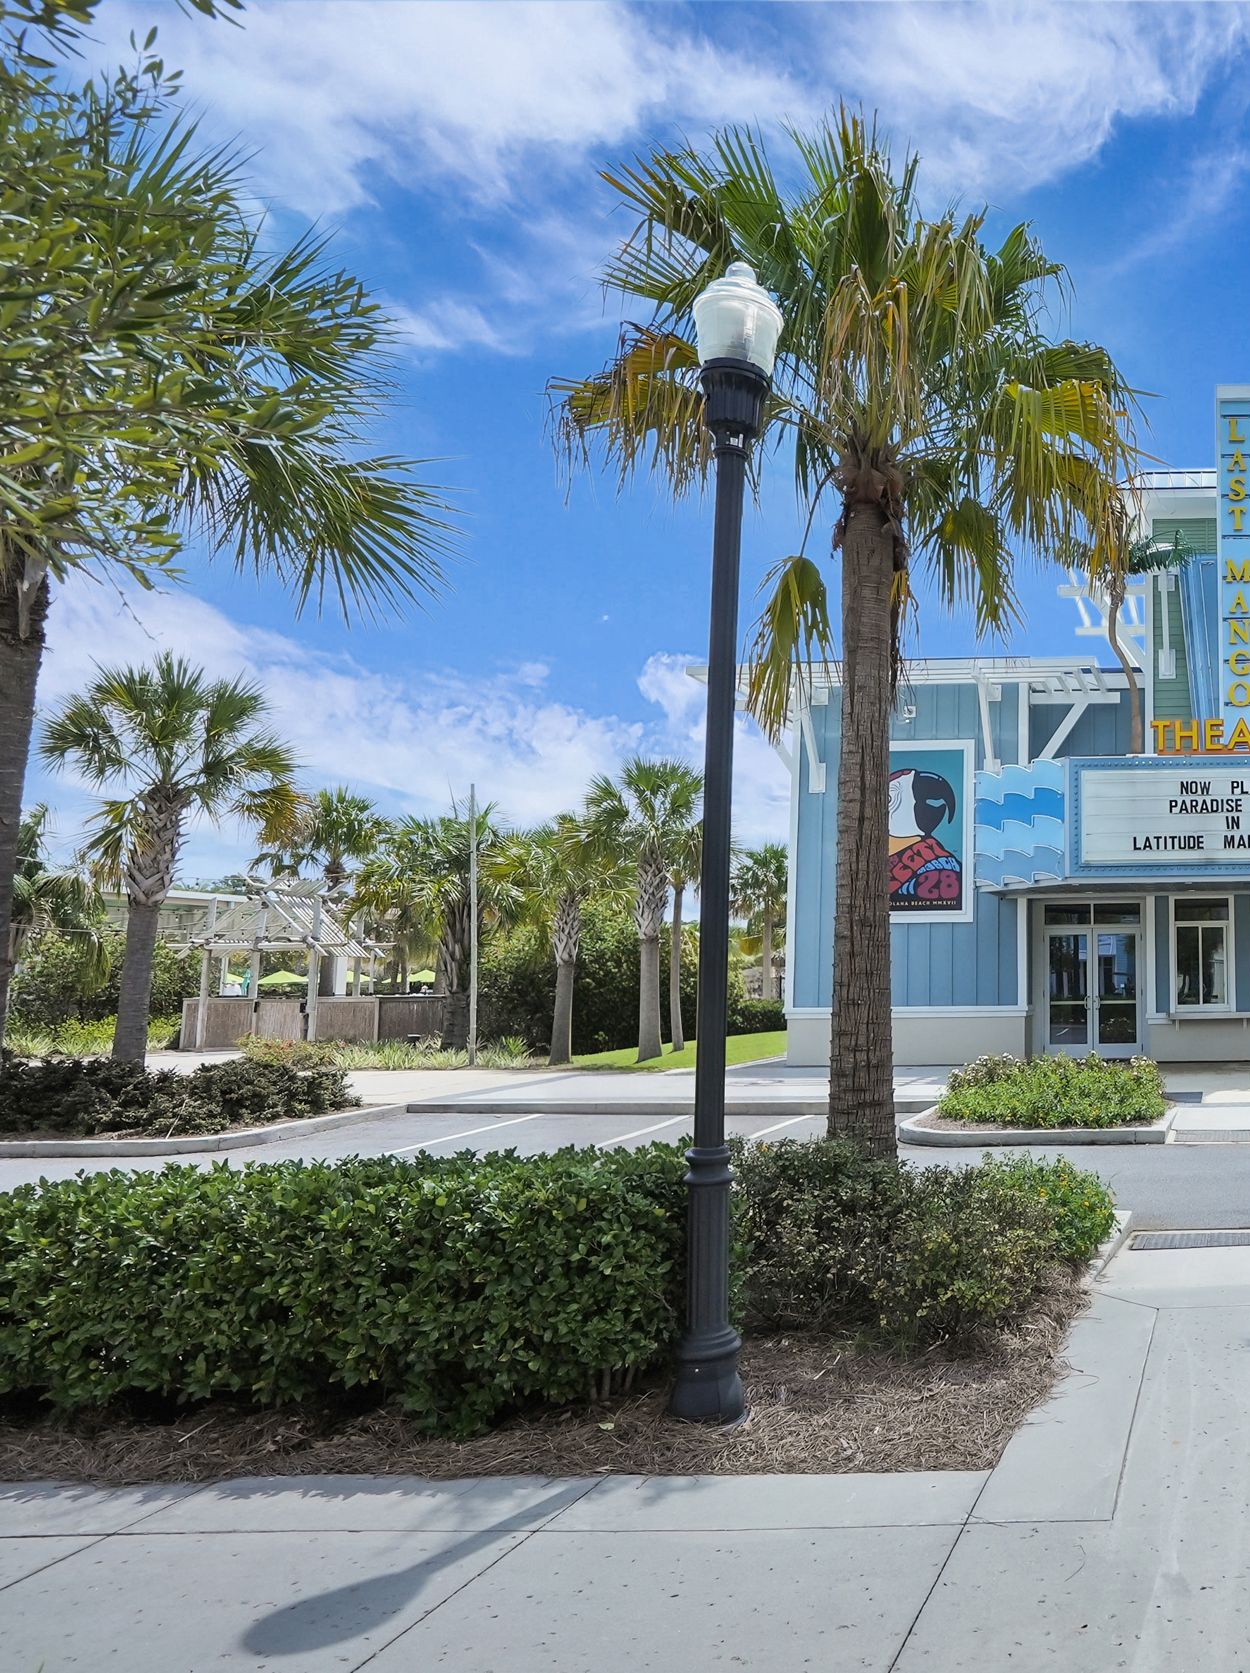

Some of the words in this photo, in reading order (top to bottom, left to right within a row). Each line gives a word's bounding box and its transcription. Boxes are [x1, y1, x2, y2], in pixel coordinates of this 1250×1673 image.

[1228, 418, 1246, 531] LAST
[1179, 780, 1212, 796] NOW
[1168, 798, 1243, 814] PARADISE
[1225, 815, 1241, 831] IN
[1132, 834, 1205, 851] LATITUDE
[917, 870, 960, 899] 28
